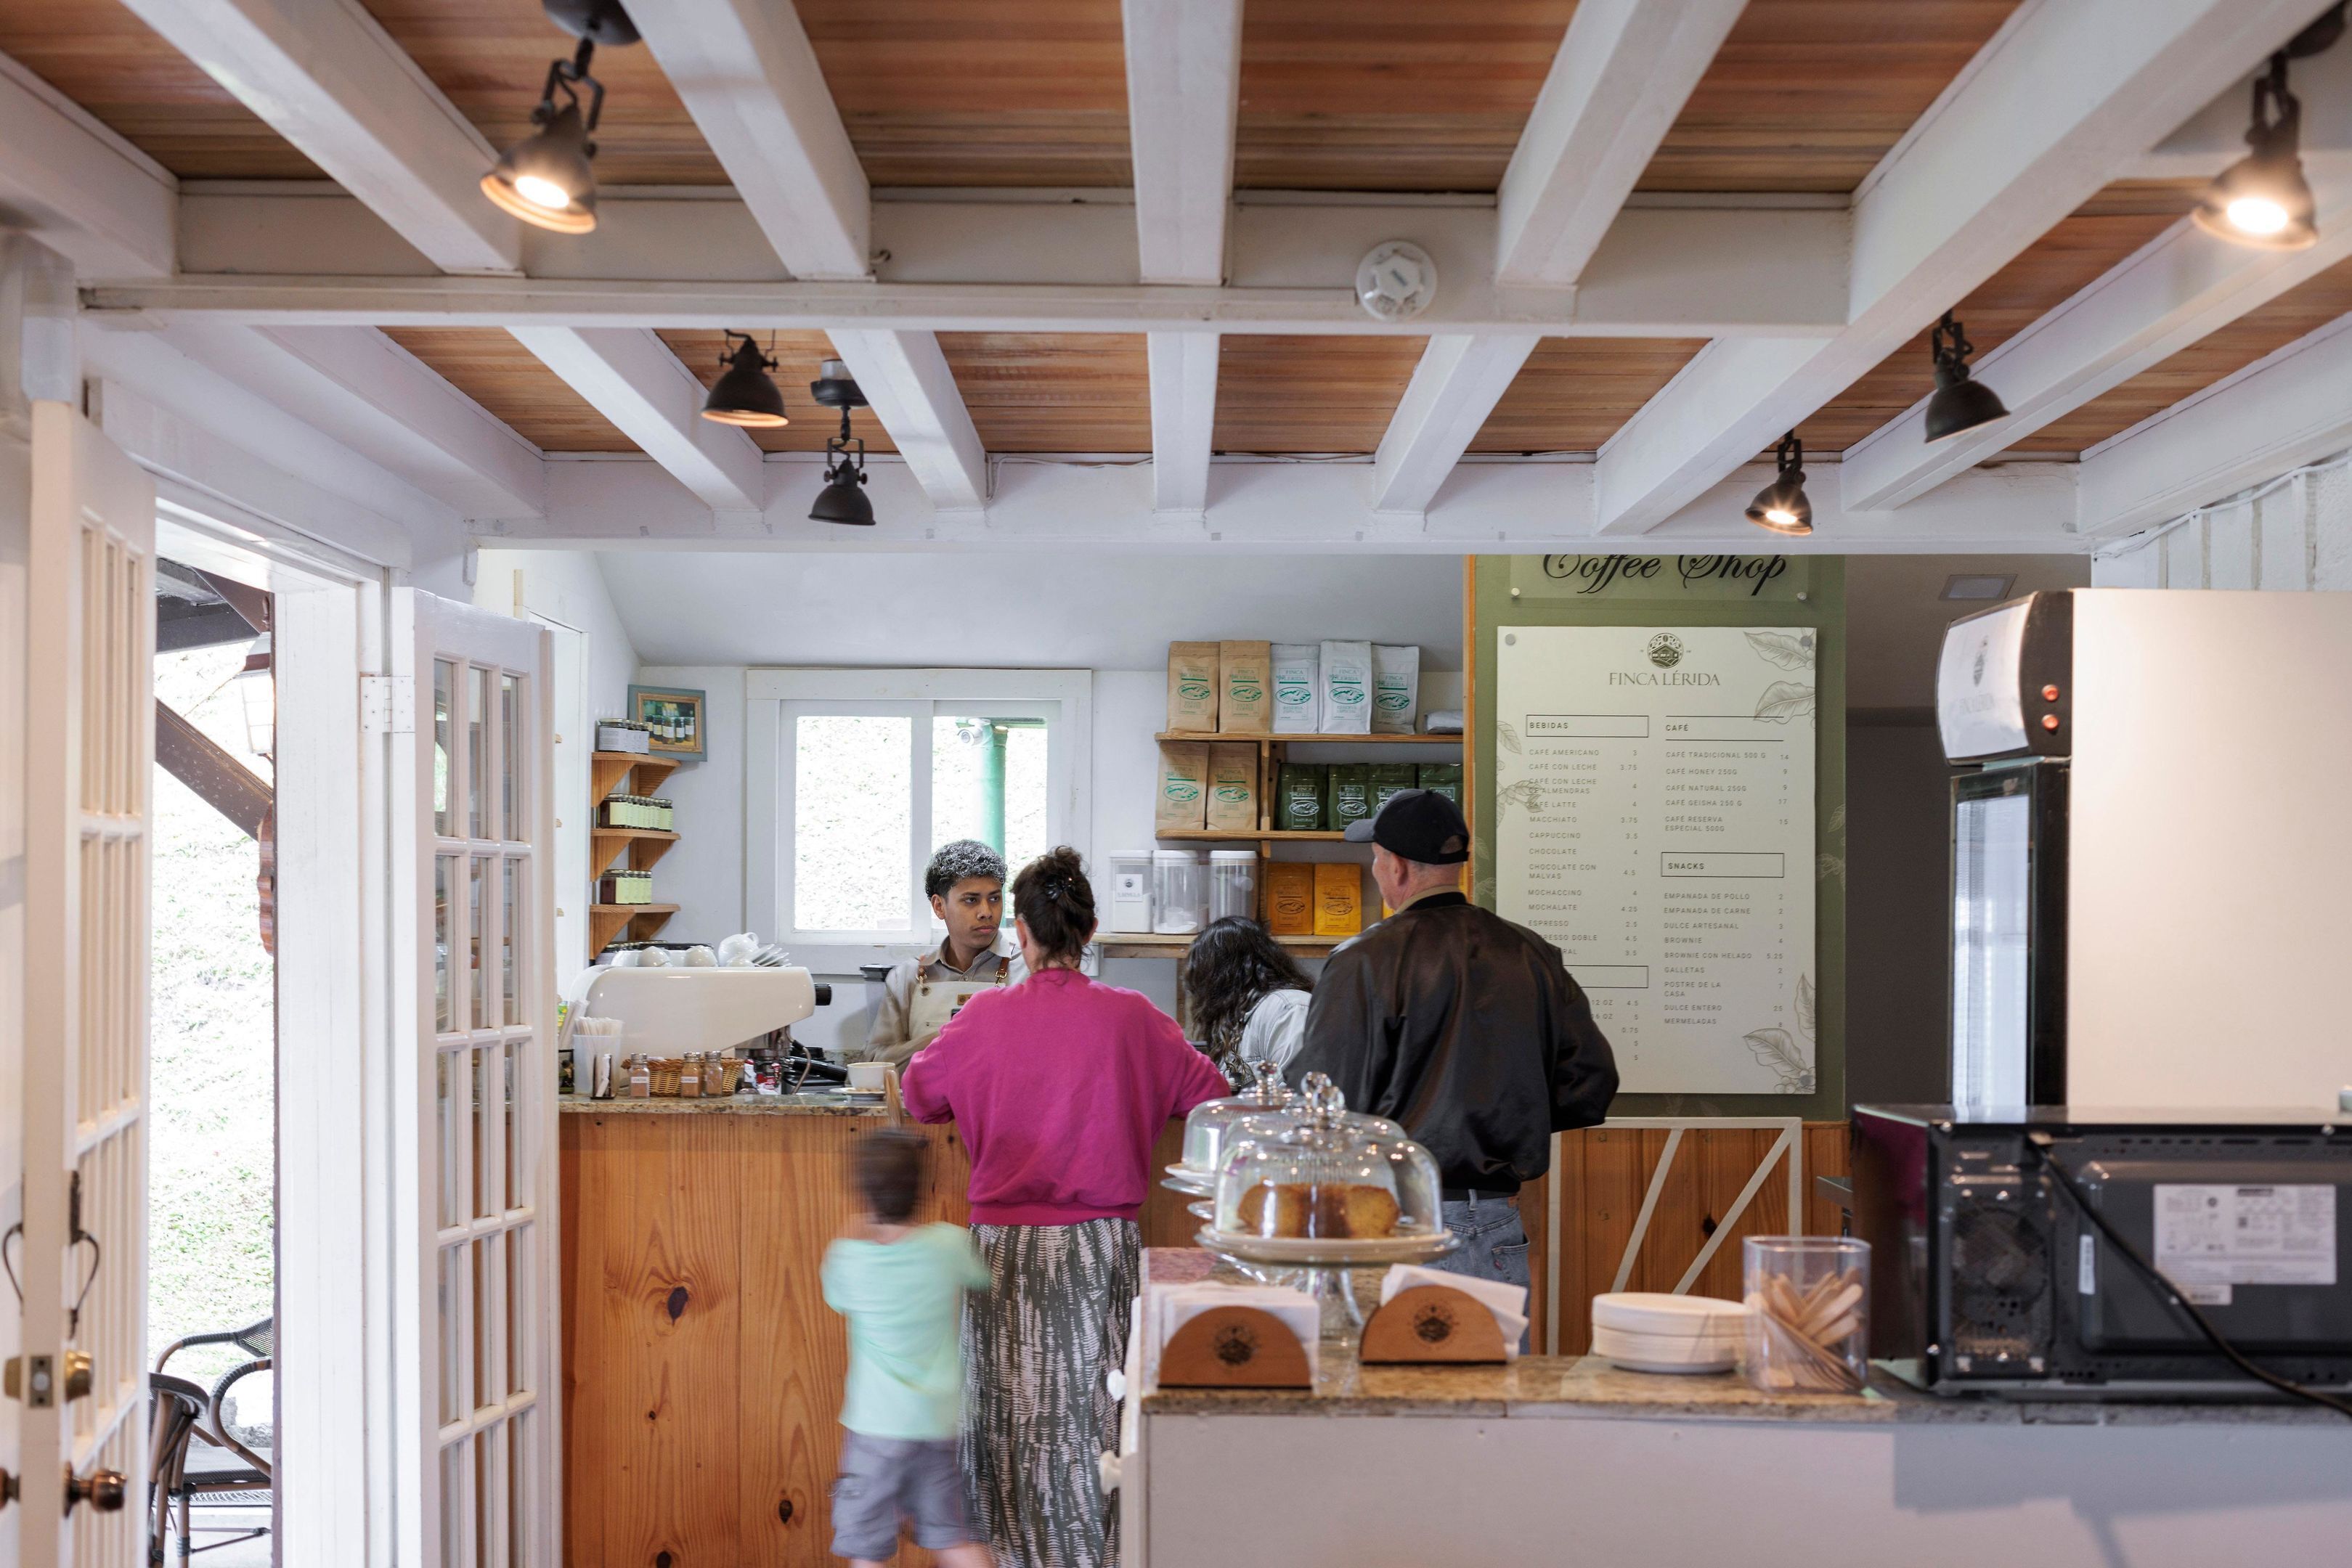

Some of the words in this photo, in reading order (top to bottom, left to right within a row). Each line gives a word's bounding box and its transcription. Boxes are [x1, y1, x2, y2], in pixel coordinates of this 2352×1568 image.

[1543, 554, 1661, 594] Coffee
[1677, 554, 1786, 596] Shop
[1608, 672, 1658, 686] FINCA
[1661, 670, 1720, 686] LÉRIDA
